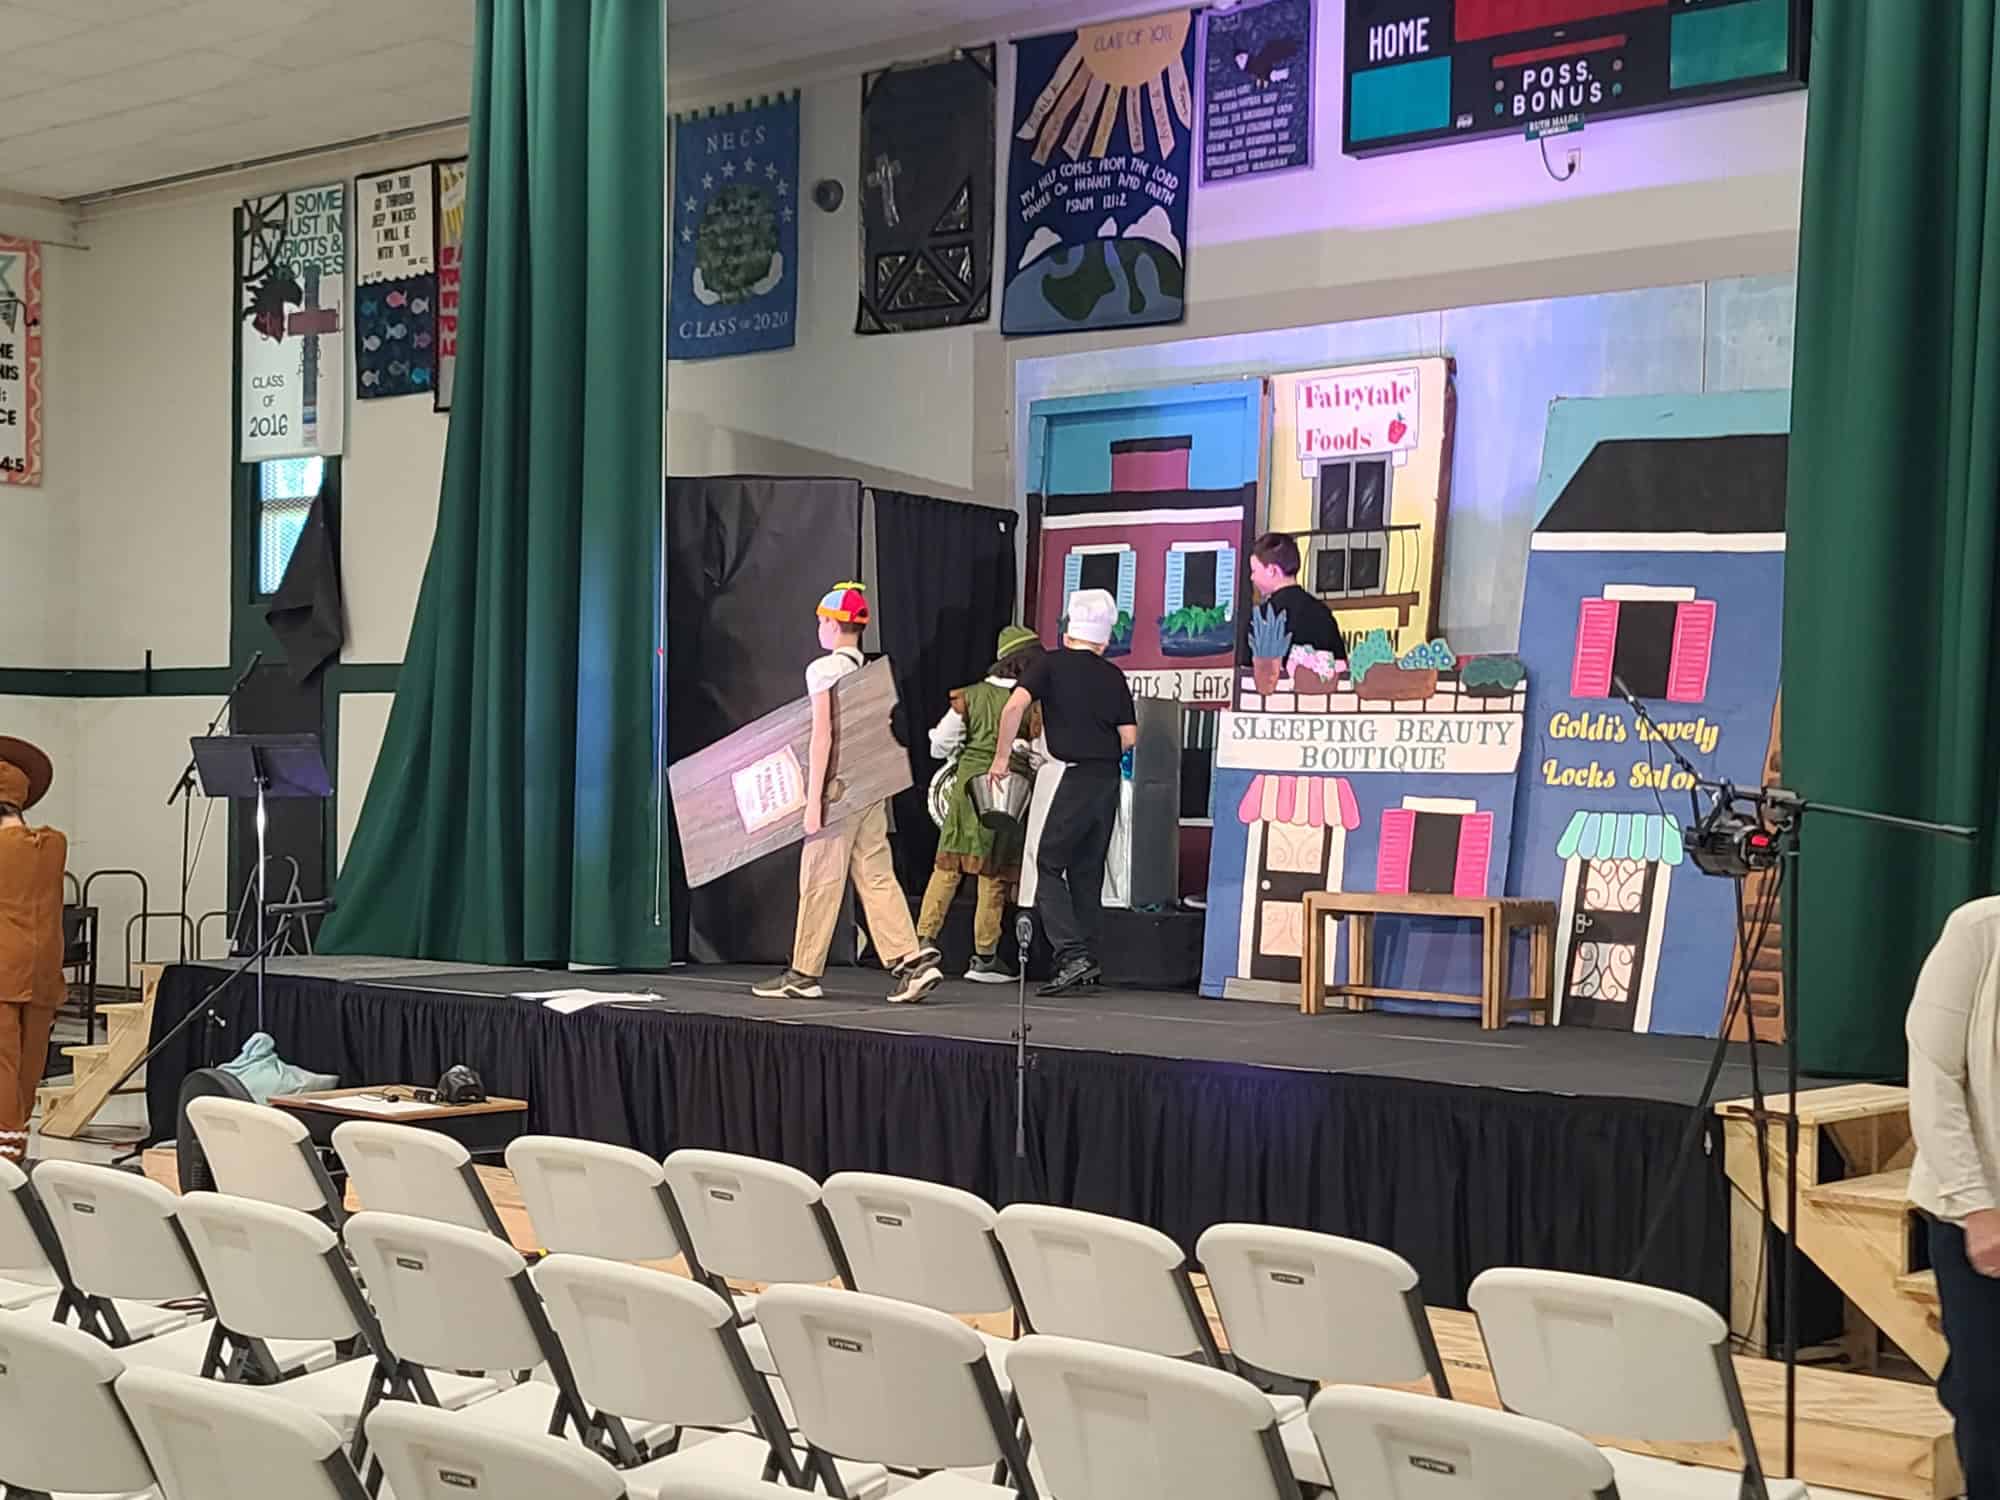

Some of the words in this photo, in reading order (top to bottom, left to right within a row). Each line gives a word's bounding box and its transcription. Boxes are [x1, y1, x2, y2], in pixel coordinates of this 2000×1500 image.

[1369, 17, 1430, 62] HOME
[1523, 60, 1593, 92] POSS.
[1513, 81, 1602, 116] BONUS
[707, 125, 767, 153] NECS
[1020, 186, 1036, 206] MY
[1038, 169, 1057, 192] HELP
[1060, 160, 1093, 177] COMES
[1099, 157, 1126, 172] FROM
[1130, 157, 1150, 176] THE
[1152, 164, 1179, 189] LORD
[1074, 174, 1111, 192] HEAVEN
[1118, 173, 1141, 191] AND
[1144, 181, 1176, 207] EARTH
[295, 188, 343, 214] SOME
[1065, 196, 1094, 213] PSALM
[269, 214, 321, 239] TUST
[327, 213, 343, 233] IN
[279, 255, 344, 278] ORES
[680, 317, 737, 339] CLASS
[752, 311, 789, 331] 2020
[252, 375, 285, 389] CLASS
[1305, 380, 1412, 412] Fairytale
[249, 414, 288, 437] 2016
[1305, 427, 1371, 452] Foods
[1171, 671, 1182, 699] 3
[1193, 673, 1232, 700] EATS
[1232, 716, 1377, 743] SLEEPING
[1395, 718, 1515, 746] BEAUTY
[1549, 711, 1627, 743] Goldi's
[1301, 745, 1447, 773] BOUTIQUE
[1542, 758, 1616, 788] Locks
